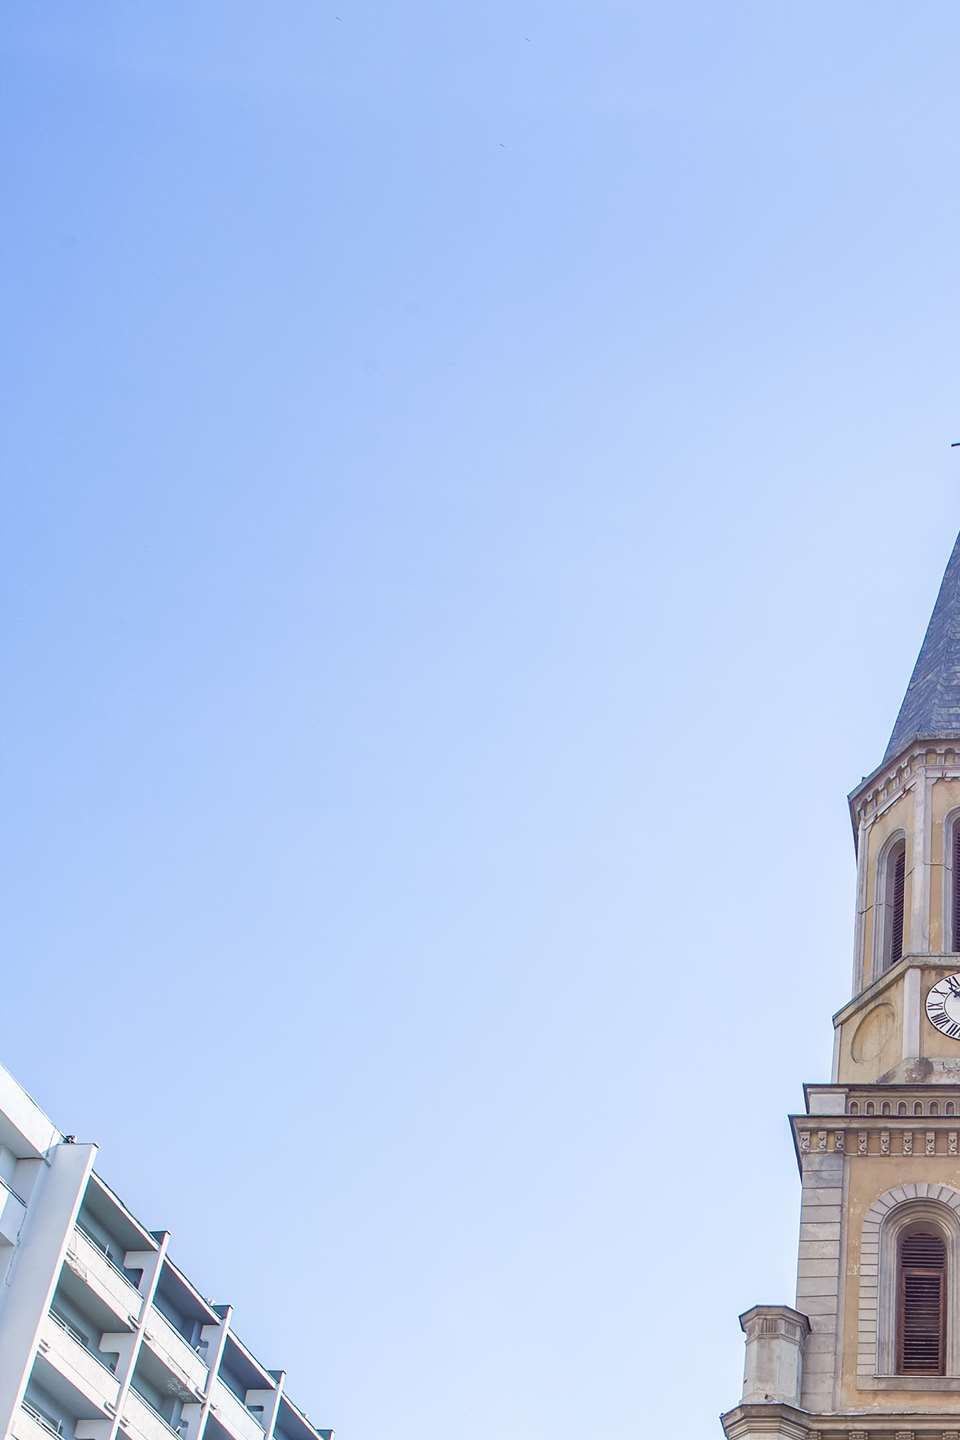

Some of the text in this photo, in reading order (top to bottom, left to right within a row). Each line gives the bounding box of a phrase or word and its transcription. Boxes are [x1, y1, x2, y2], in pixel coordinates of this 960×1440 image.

[945, 975, 960, 988] XI
[932, 988, 948, 998] X
[928, 1002, 943, 1010] IX
